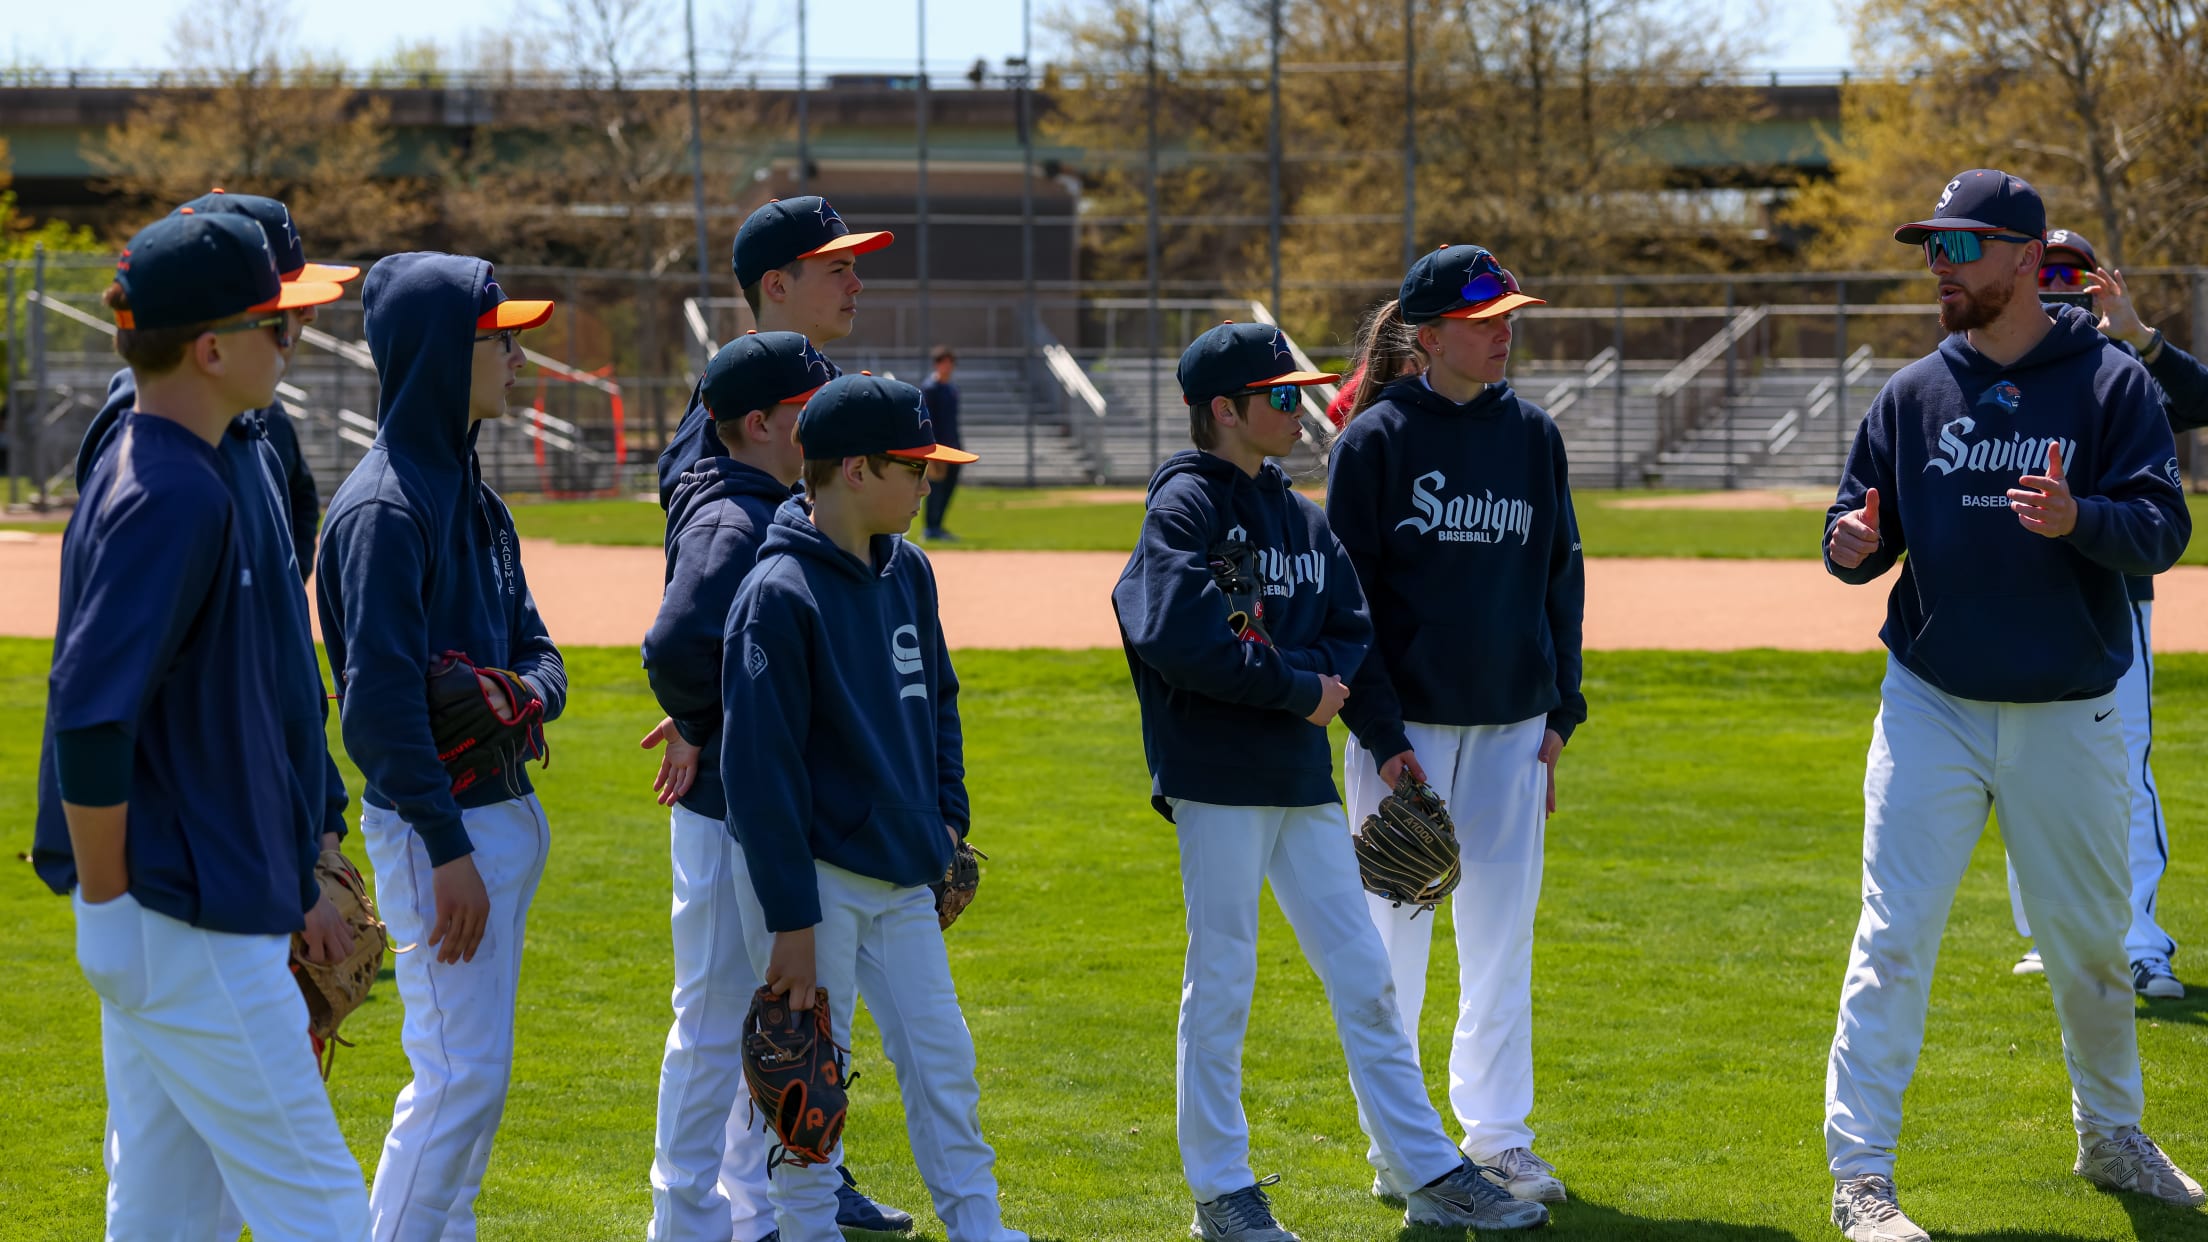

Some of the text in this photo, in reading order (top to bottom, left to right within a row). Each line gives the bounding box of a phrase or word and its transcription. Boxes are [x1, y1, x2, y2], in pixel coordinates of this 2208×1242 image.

[1935, 179, 1961, 212] S
[1922, 415, 2077, 477] Savigny
[1394, 470, 1534, 546] Savigny
[1438, 530, 1492, 544] BASEBALL
[499, 528, 516, 595] ACADEMIE
